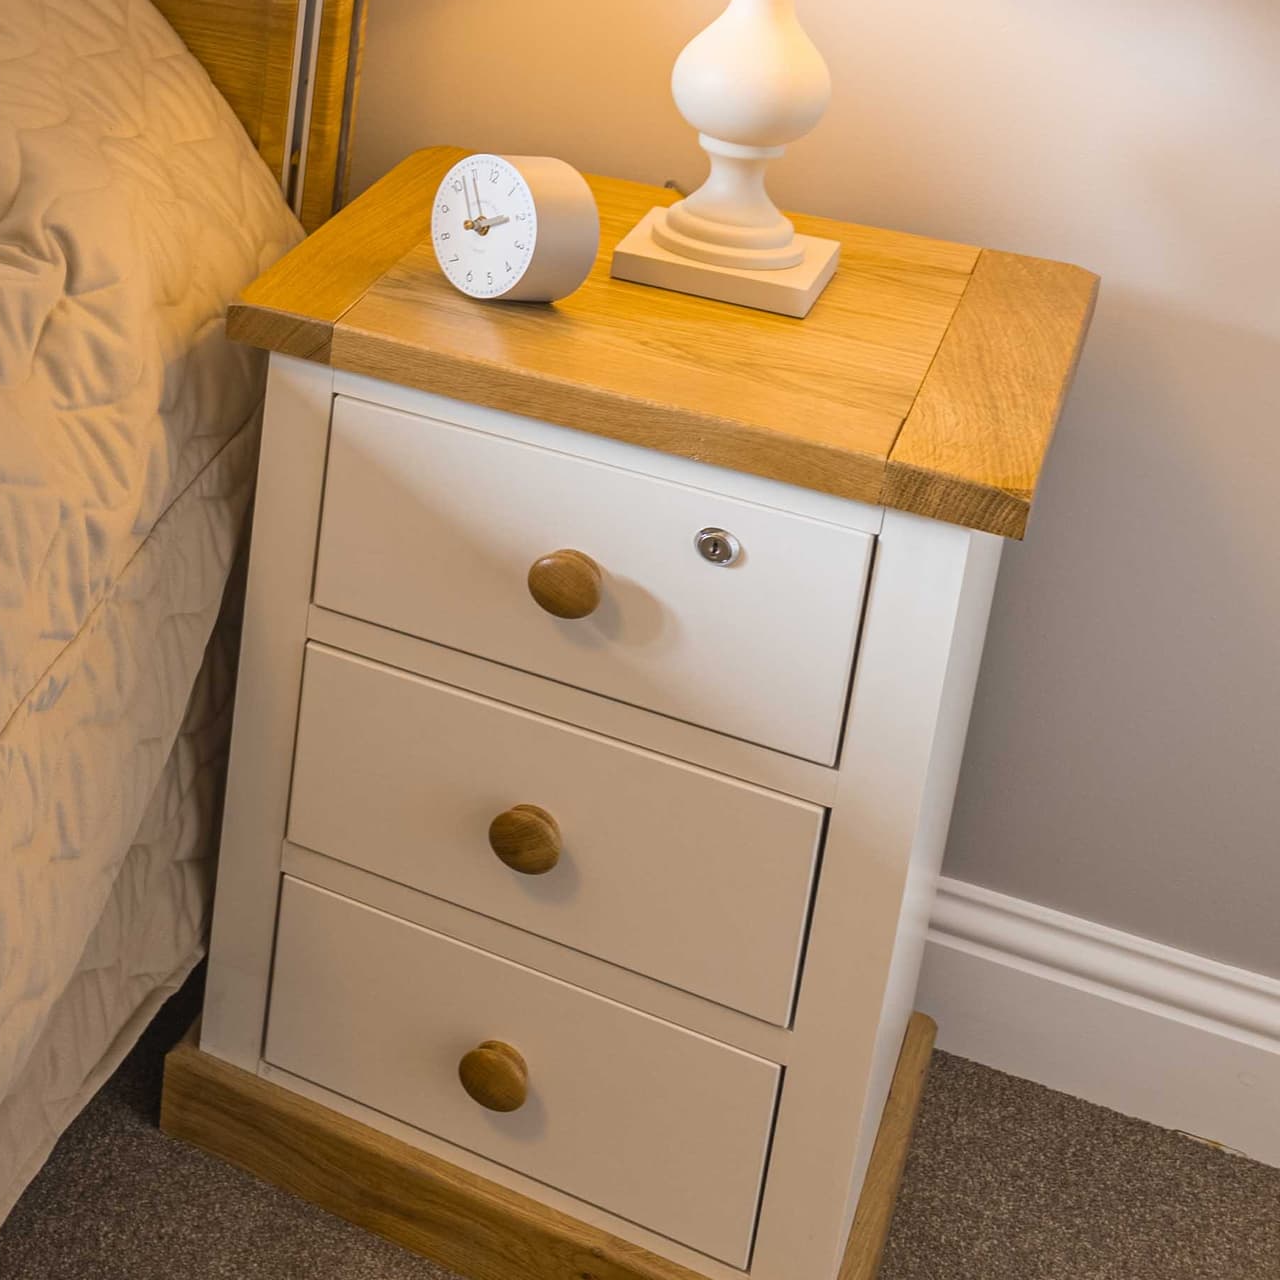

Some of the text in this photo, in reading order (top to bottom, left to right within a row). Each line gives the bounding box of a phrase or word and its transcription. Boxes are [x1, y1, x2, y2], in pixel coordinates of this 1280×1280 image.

[489, 169, 500, 184] 12
[466, 270, 474, 283] 6
[486, 272, 493, 285] 5
